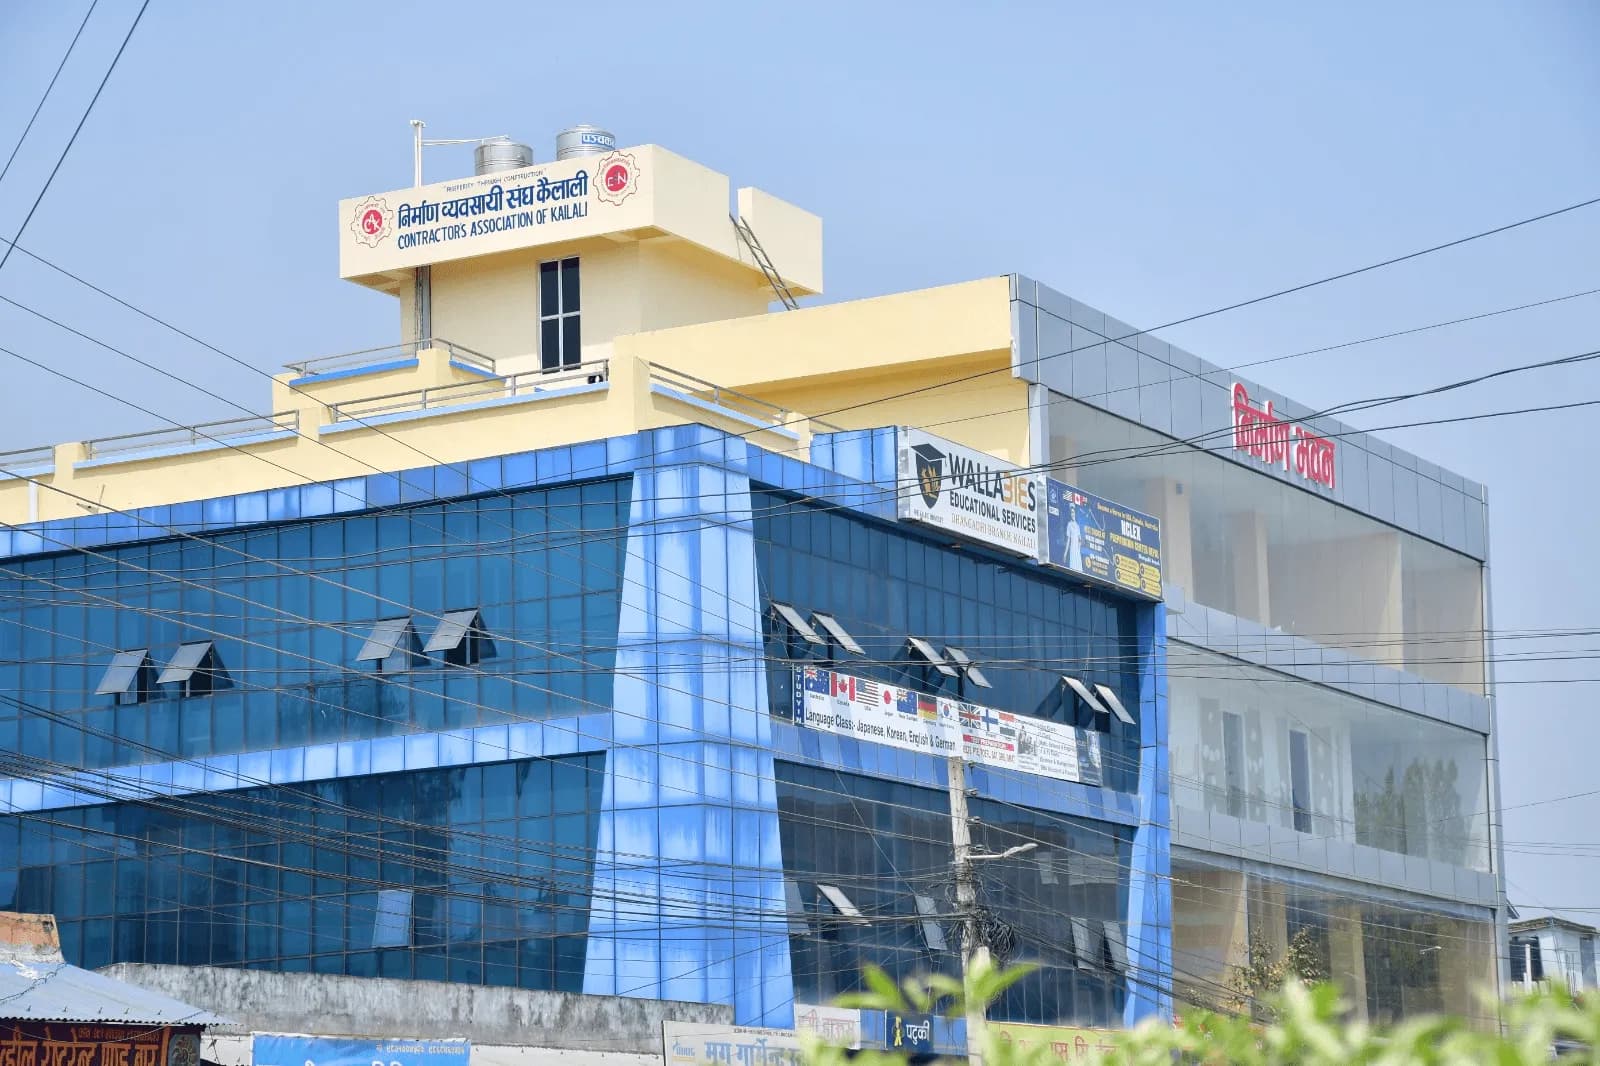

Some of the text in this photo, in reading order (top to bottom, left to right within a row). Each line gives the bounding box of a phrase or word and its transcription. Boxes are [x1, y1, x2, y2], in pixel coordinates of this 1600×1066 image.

[398, 170, 588, 229] निर्माण व्यवसायी संघ कैलाली
[470, 212, 533, 237] ASSOCIATION
[536, 208, 549, 225] OF
[551, 201, 588, 222] KAILALI
[1231, 382, 1336, 489] निर्माण भवन
[948, 452, 1036, 512] WALLABIES
[950, 490, 1000, 521] EDUCATIONAL
[1002, 508, 1036, 534] SERVICES
[805, 706, 834, 728] Language
[857, 721, 886, 738] Japanese,
[909, 731, 929, 747] English
[935, 736, 956, 750] German
[905, 1020, 930, 1046] पटुकी
